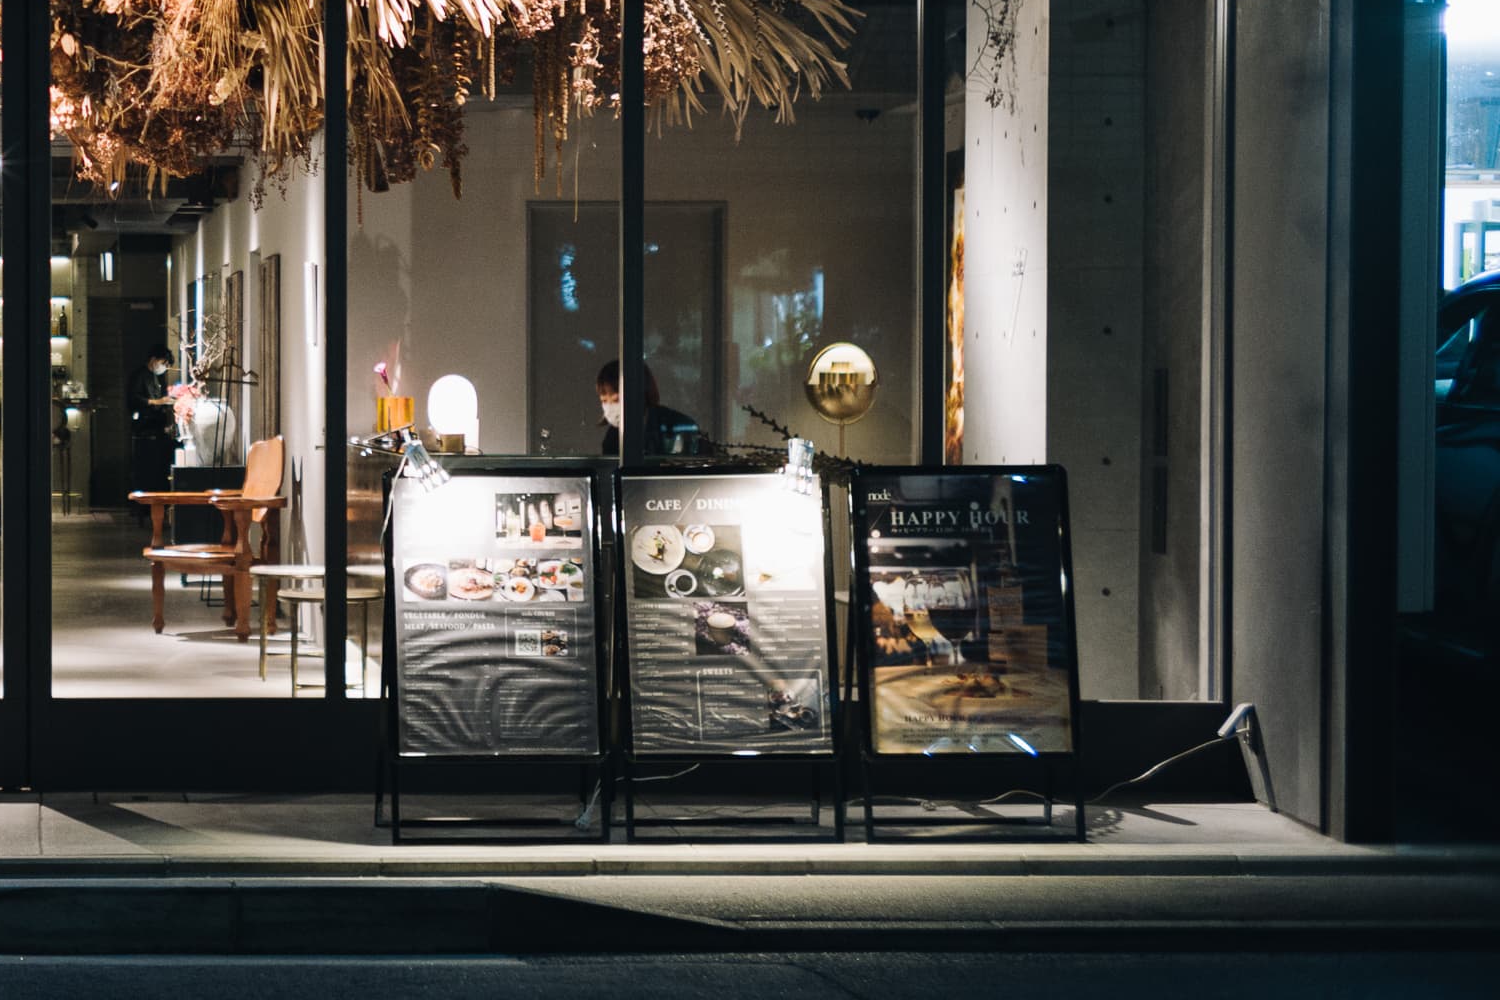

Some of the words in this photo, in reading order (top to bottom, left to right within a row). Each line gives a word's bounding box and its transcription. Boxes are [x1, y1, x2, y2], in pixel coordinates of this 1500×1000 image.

[867, 488, 891, 501] node
[645, 499, 682, 511] CAFE
[696, 498, 744, 511] DINI
[890, 510, 961, 526] HAPPY
[969, 509, 1030, 525] HOUR
[702, 667, 733, 675] SWEETS
